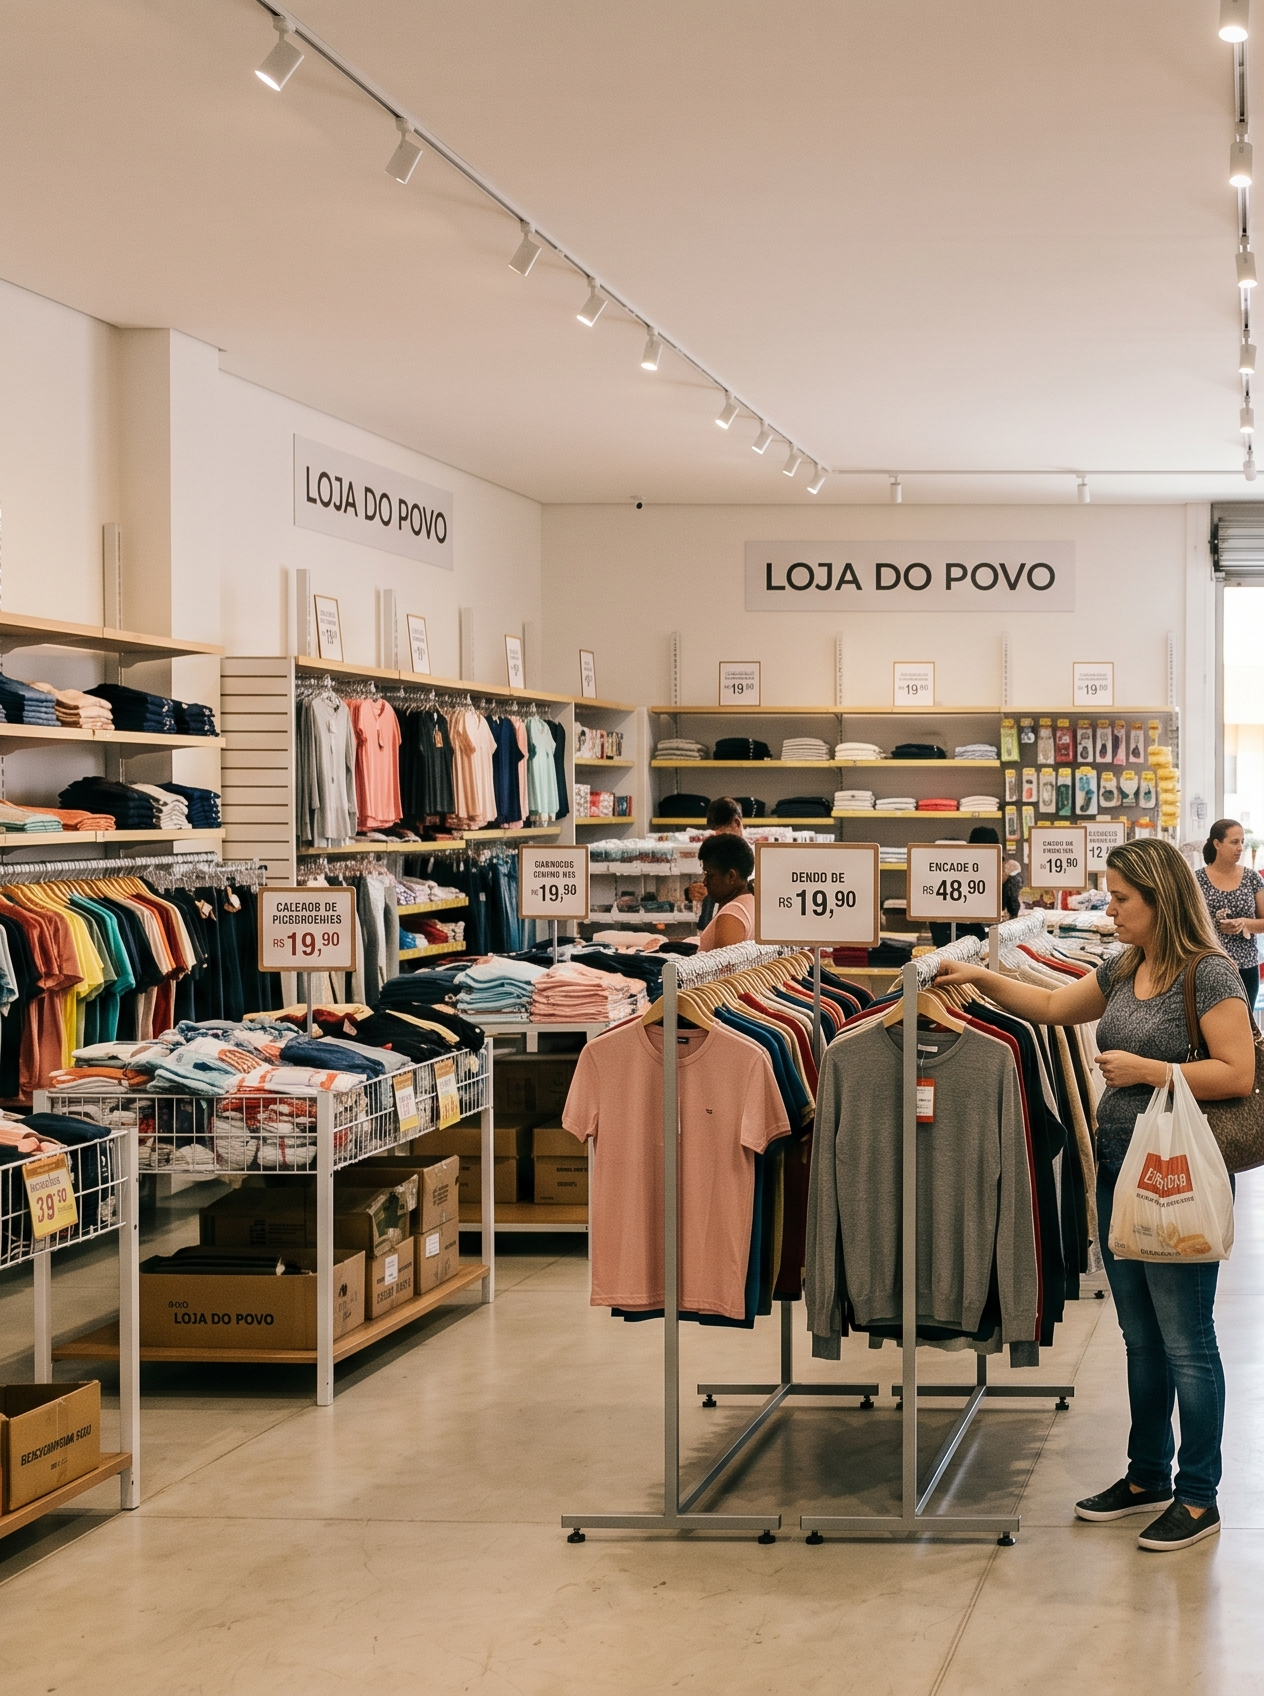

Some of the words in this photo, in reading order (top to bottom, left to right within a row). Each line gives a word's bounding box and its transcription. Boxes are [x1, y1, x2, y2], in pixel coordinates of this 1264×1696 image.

[306, 466, 358, 517] LOJA
[364, 485, 392, 527] DO
[398, 497, 447, 544] POVO
[766, 562, 863, 592] LOJA
[875, 562, 932, 591] DO
[945, 562, 1056, 591] POVO
[791, 872, 828, 883] DENDO
[929, 862, 969, 872] ENCADE
[935, 879, 986, 903] 48,90
[324, 902, 338, 912] DE
[796, 889, 857, 919] 19,90
[287, 932, 340, 957] 19,90
[174, 1312, 208, 1324] LOJA
[211, 1313, 232, 1325] DO
[236, 1313, 275, 1325] POVO
